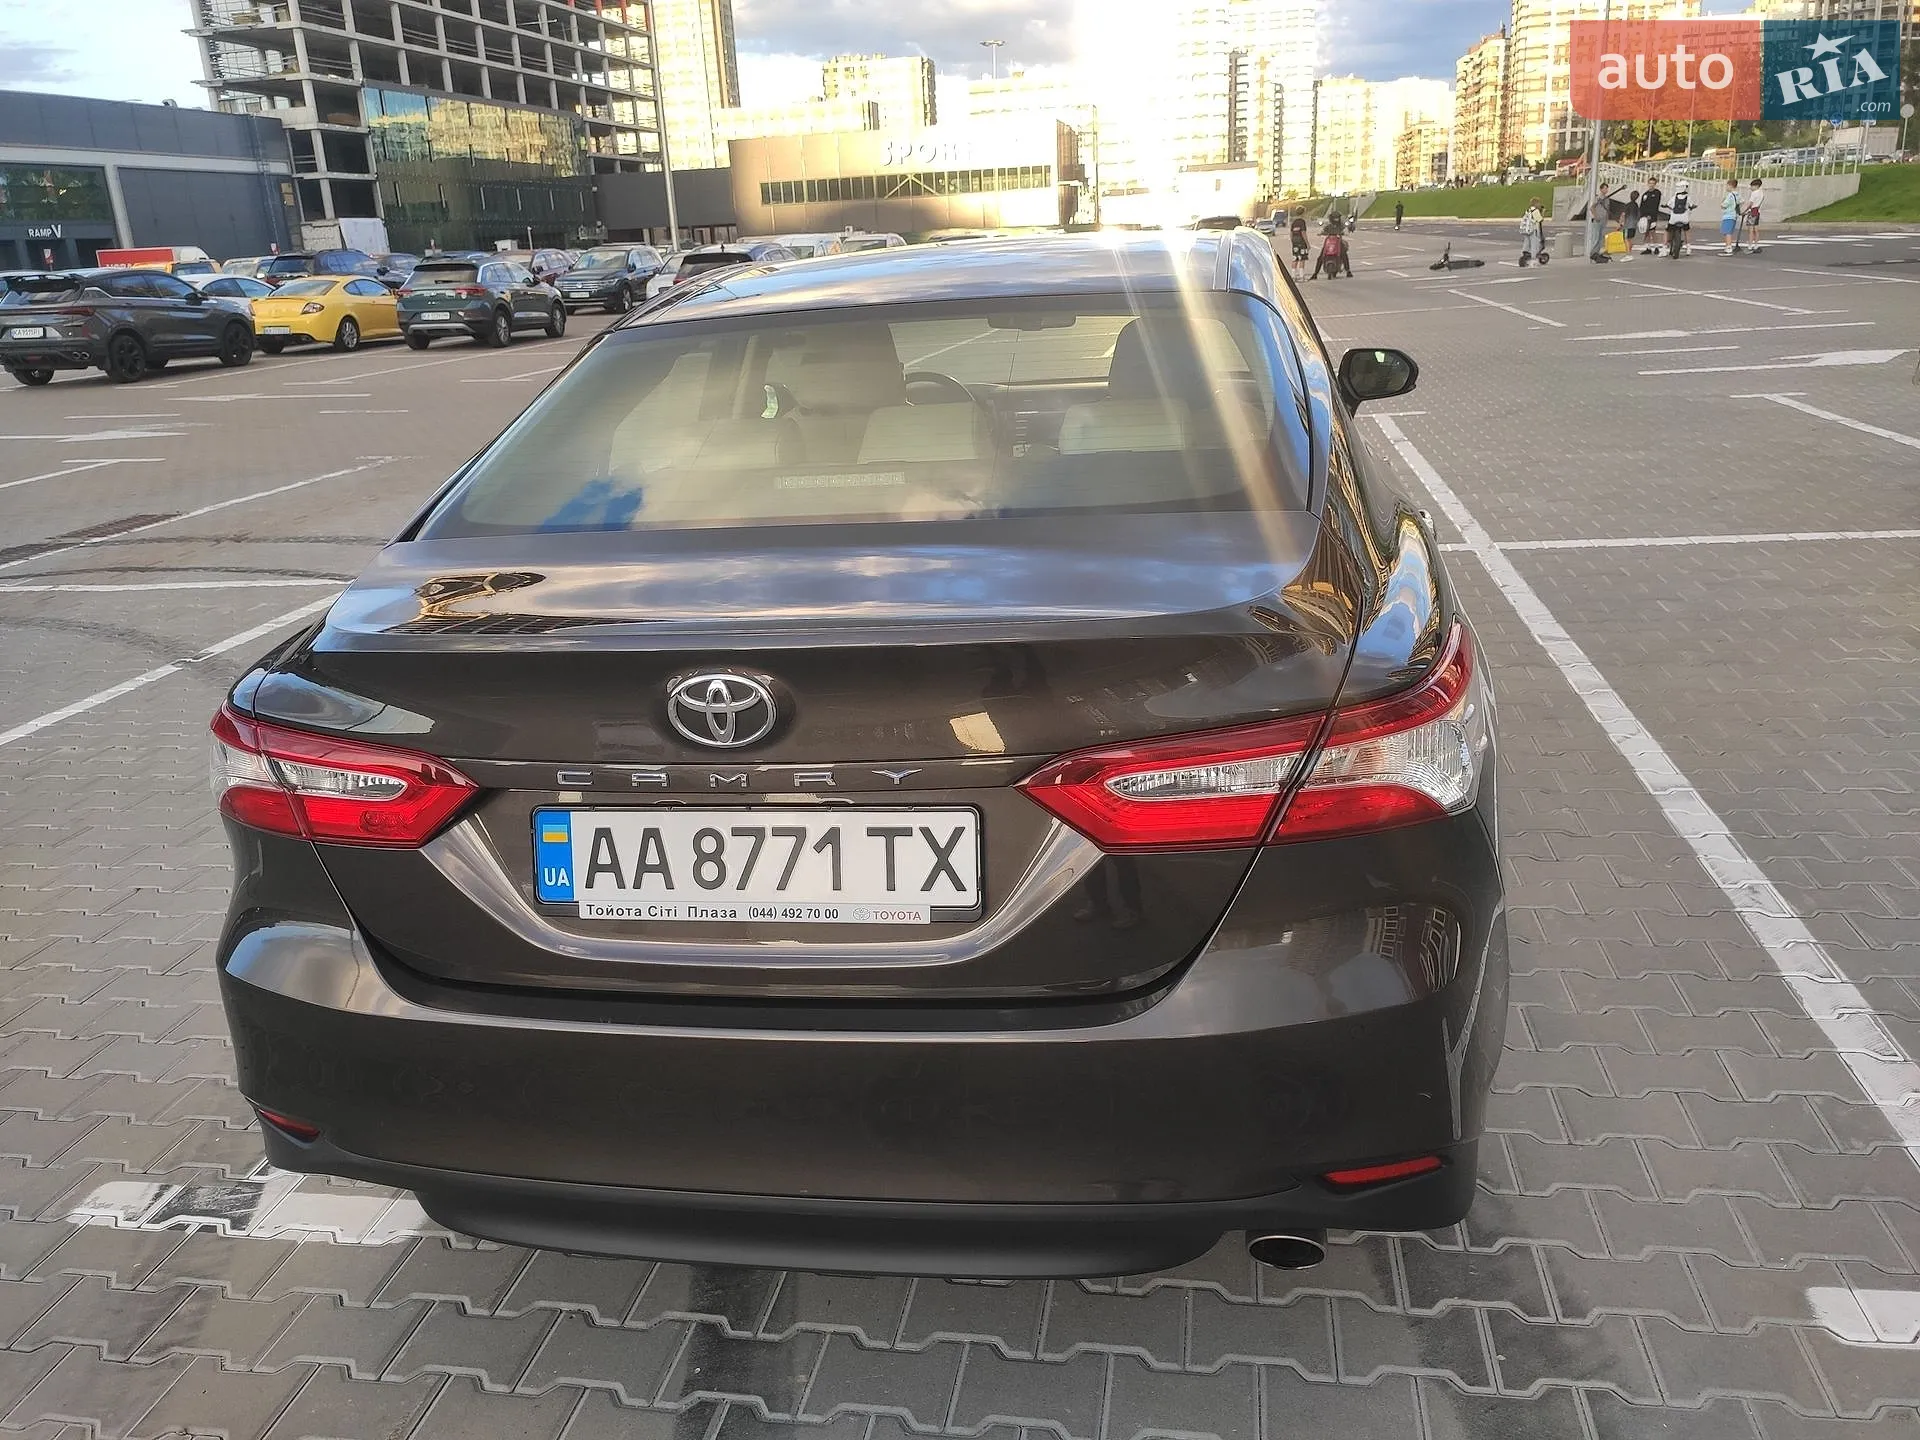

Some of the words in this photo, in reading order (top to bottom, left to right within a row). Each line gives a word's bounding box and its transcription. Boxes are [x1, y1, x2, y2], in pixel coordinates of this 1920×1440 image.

[880, 139, 978, 167] SPO
[556, 769, 923, 787] CAMRY
[584, 826, 675, 891] AA
[692, 826, 842, 891] 8771
[866, 826, 967, 892] TX
[543, 868, 571, 888] UA
[586, 903, 643, 918] Тойота
[647, 904, 678, 918] Сіті
[687, 906, 738, 919] Плаза
[748, 906, 778, 920] (044)
[781, 908, 803, 920] 492
[806, 908, 821, 920] 70
[824, 908, 839, 920] 00
[872, 910, 922, 921] TOYOTA
